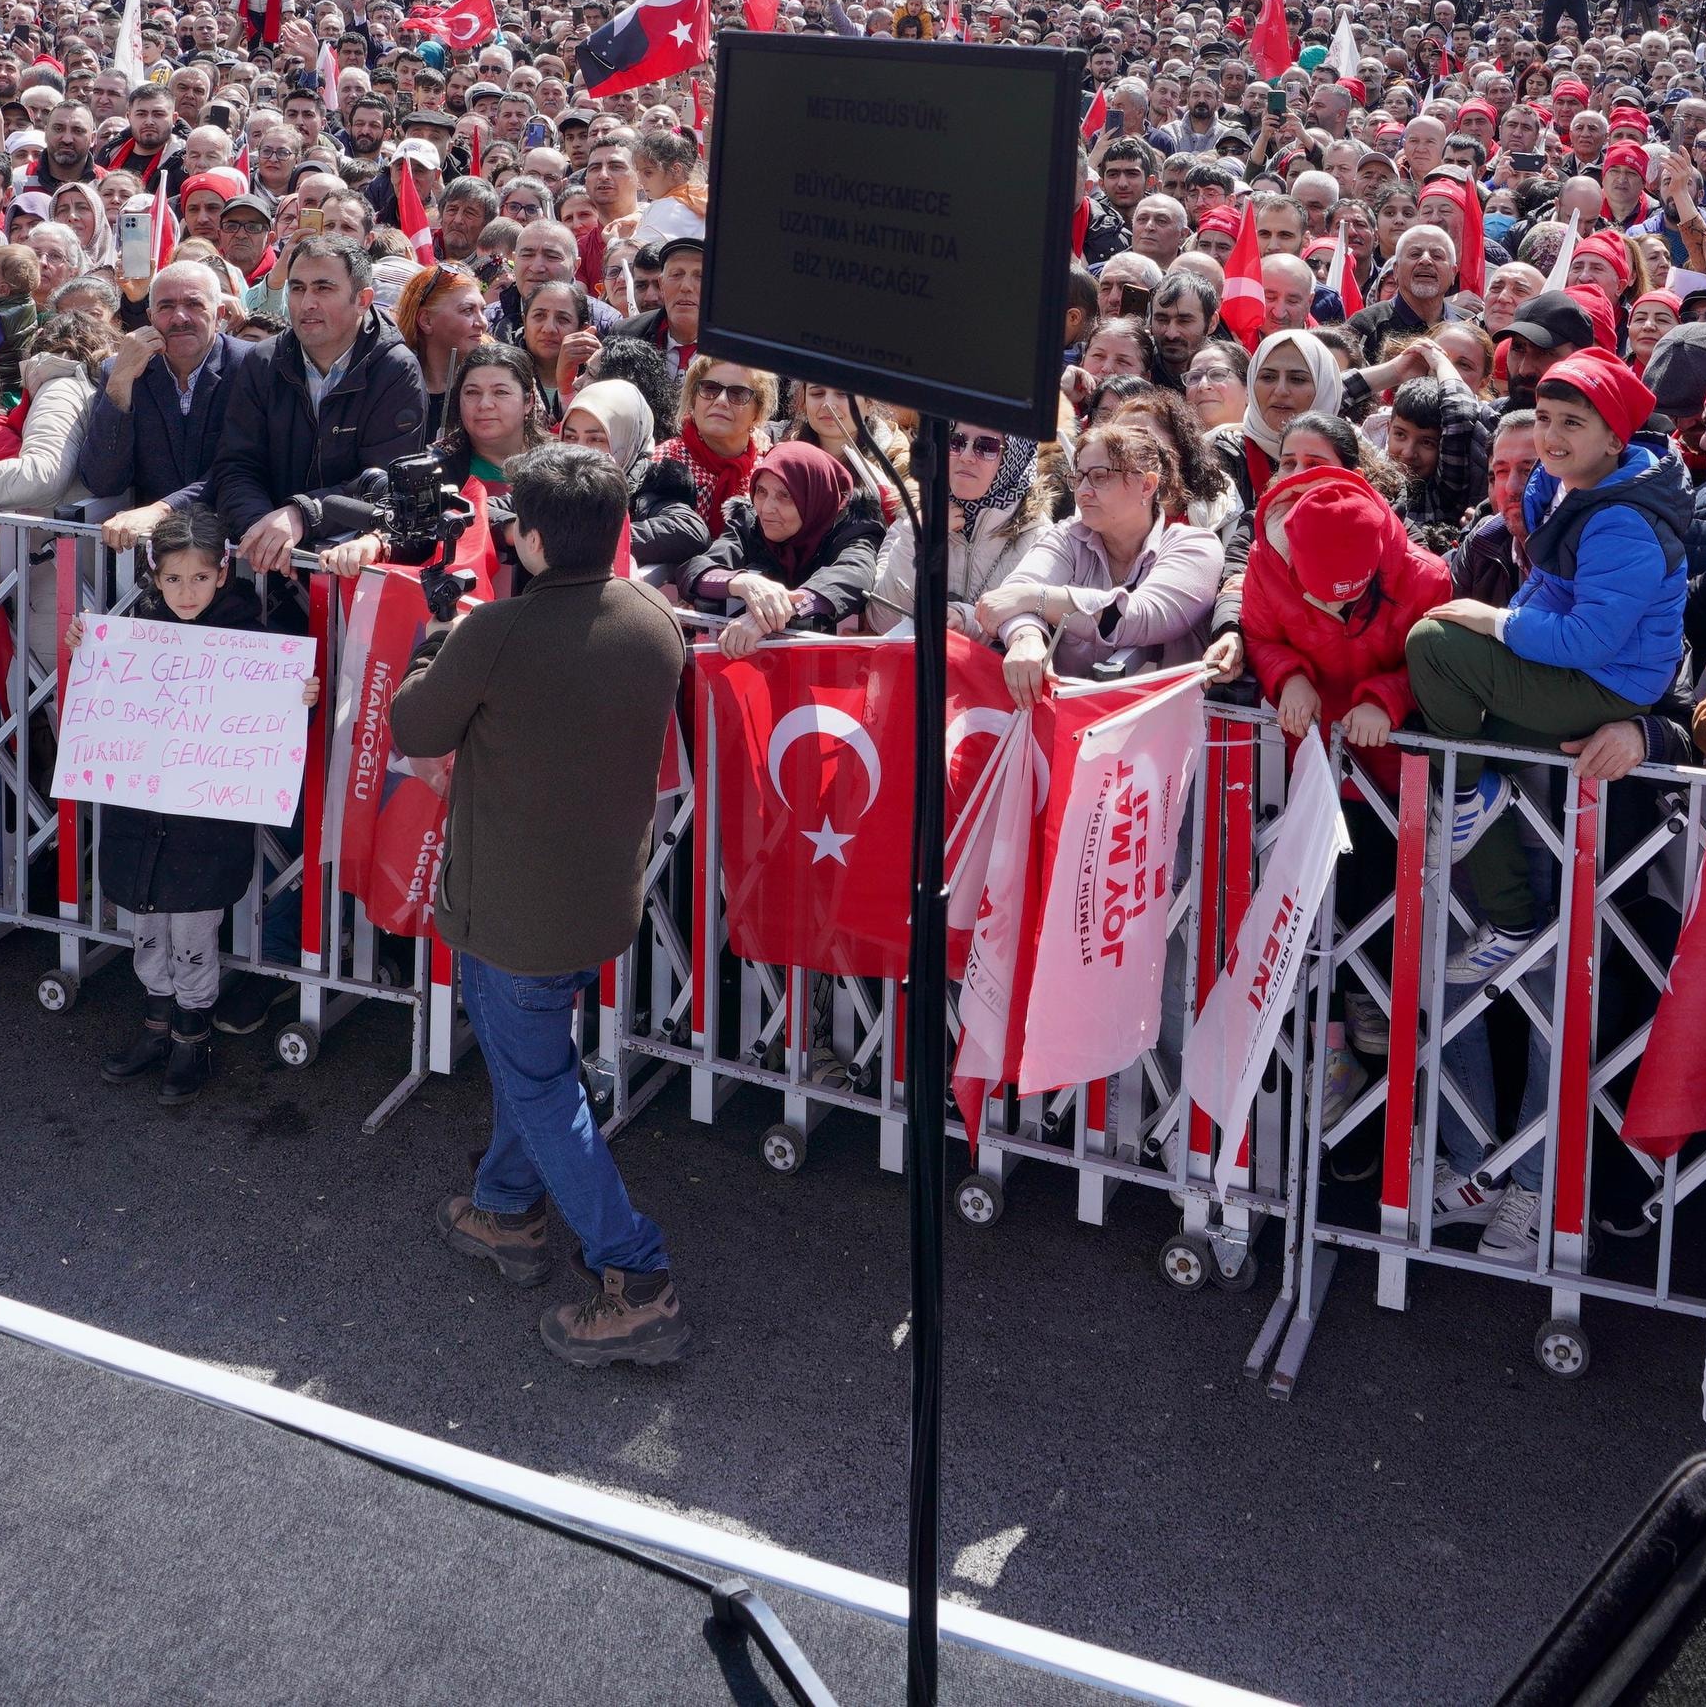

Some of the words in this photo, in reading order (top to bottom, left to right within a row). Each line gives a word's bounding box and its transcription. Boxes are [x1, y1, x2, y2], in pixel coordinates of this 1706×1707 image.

[794, 169, 952, 217] BÜYÜKÇEKMECE
[778, 208, 848, 244] UZATMA
[853, 221, 925, 255] HATTINI
[930, 234, 958, 262] DA
[792, 248, 821, 278] BİZ
[71, 649, 143, 687] YAZ
[151, 652, 219, 682] GELDİ
[223, 656, 308, 683] ÇİÇEKLER
[155, 683, 215, 705] AÇTI
[67, 697, 115, 726] EKO
[117, 701, 212, 734] BAŞKAN
[220, 710, 292, 734] GELDİ
[354, 659, 391, 801] İMAMOĞLU
[160, 738, 284, 773] GENÇLEŞTİ
[406, 829, 437, 903] olacak
